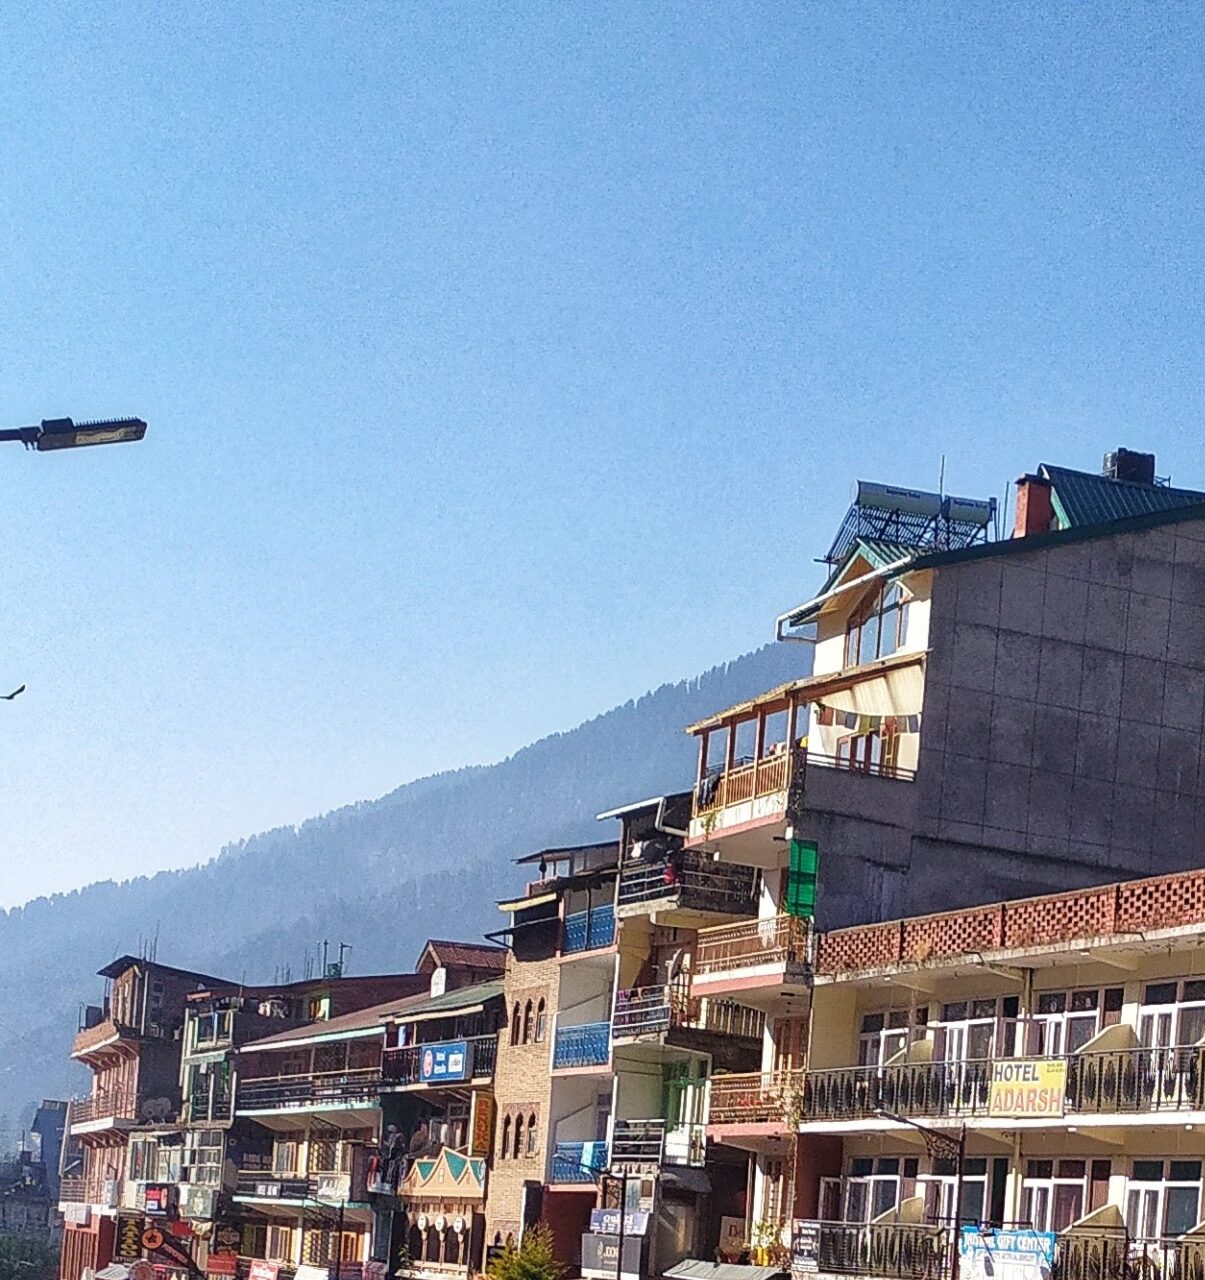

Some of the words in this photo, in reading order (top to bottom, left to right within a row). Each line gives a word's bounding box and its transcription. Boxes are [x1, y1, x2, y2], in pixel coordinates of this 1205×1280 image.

[993, 1063, 1039, 1082] HOTEL
[991, 1087, 1062, 1112] ADARSH
[997, 1235, 1016, 1250] GIFT
